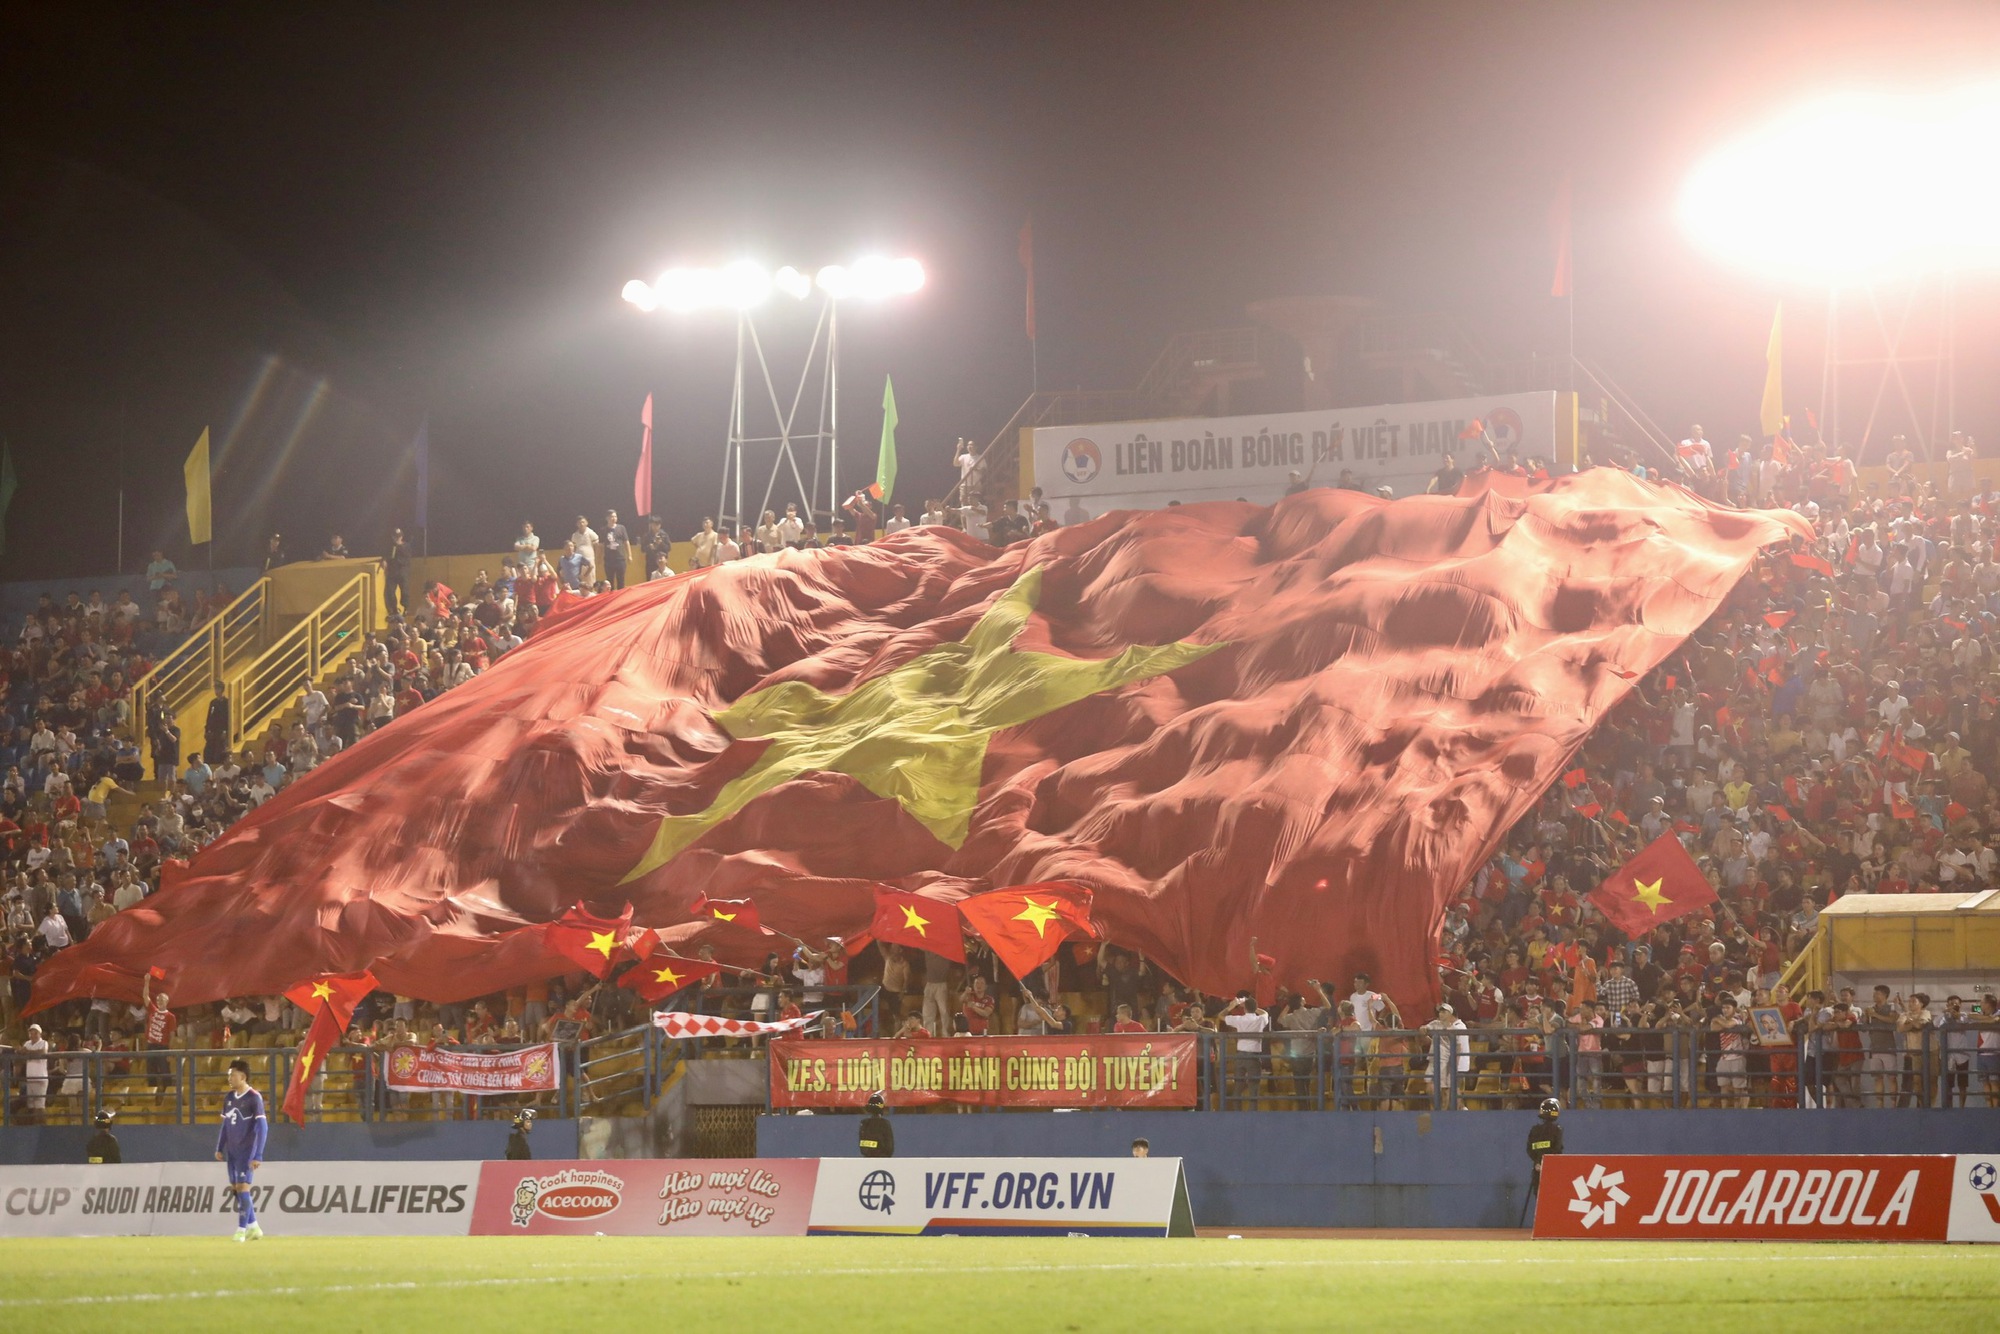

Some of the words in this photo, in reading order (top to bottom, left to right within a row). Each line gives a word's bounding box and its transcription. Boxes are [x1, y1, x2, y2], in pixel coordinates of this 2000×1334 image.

[1115, 433, 1163, 476] LIÊN
[1171, 430, 1233, 473] ĐOÀN
[1241, 427, 1304, 469] BÓNG
[1312, 421, 1345, 464] ĐÁ
[1351, 418, 1400, 466] VIỆT
[1409, 419, 1466, 457] NAM
[787, 1058, 832, 1092] V.F.S.
[837, 1051, 885, 1092] LUÔN
[891, 1046, 943, 1091] ĐỒNG
[948, 1050, 1000, 1091] HÀNH
[1006, 1049, 1060, 1091] CÙNG
[1064, 1049, 1097, 1098] ĐỘI
[1103, 1043, 1165, 1091] TUYỂN
[540, 1173, 567, 1190] Cook
[571, 1171, 623, 1190] happiness
[708, 1168, 750, 1194] mọi
[748, 1169, 780, 1197] lúc
[925, 1171, 1115, 1210] VFF.ORG.VN
[1638, 1169, 1921, 1226] JOGARBOLA
[5, 1187, 71, 1216] CUP
[82, 1187, 141, 1215] SAUDI
[143, 1186, 215, 1213] ARABIA
[279, 1184, 468, 1214] QUALIFIERS
[707, 1196, 748, 1221] mọi
[745, 1202, 775, 1228] sự
